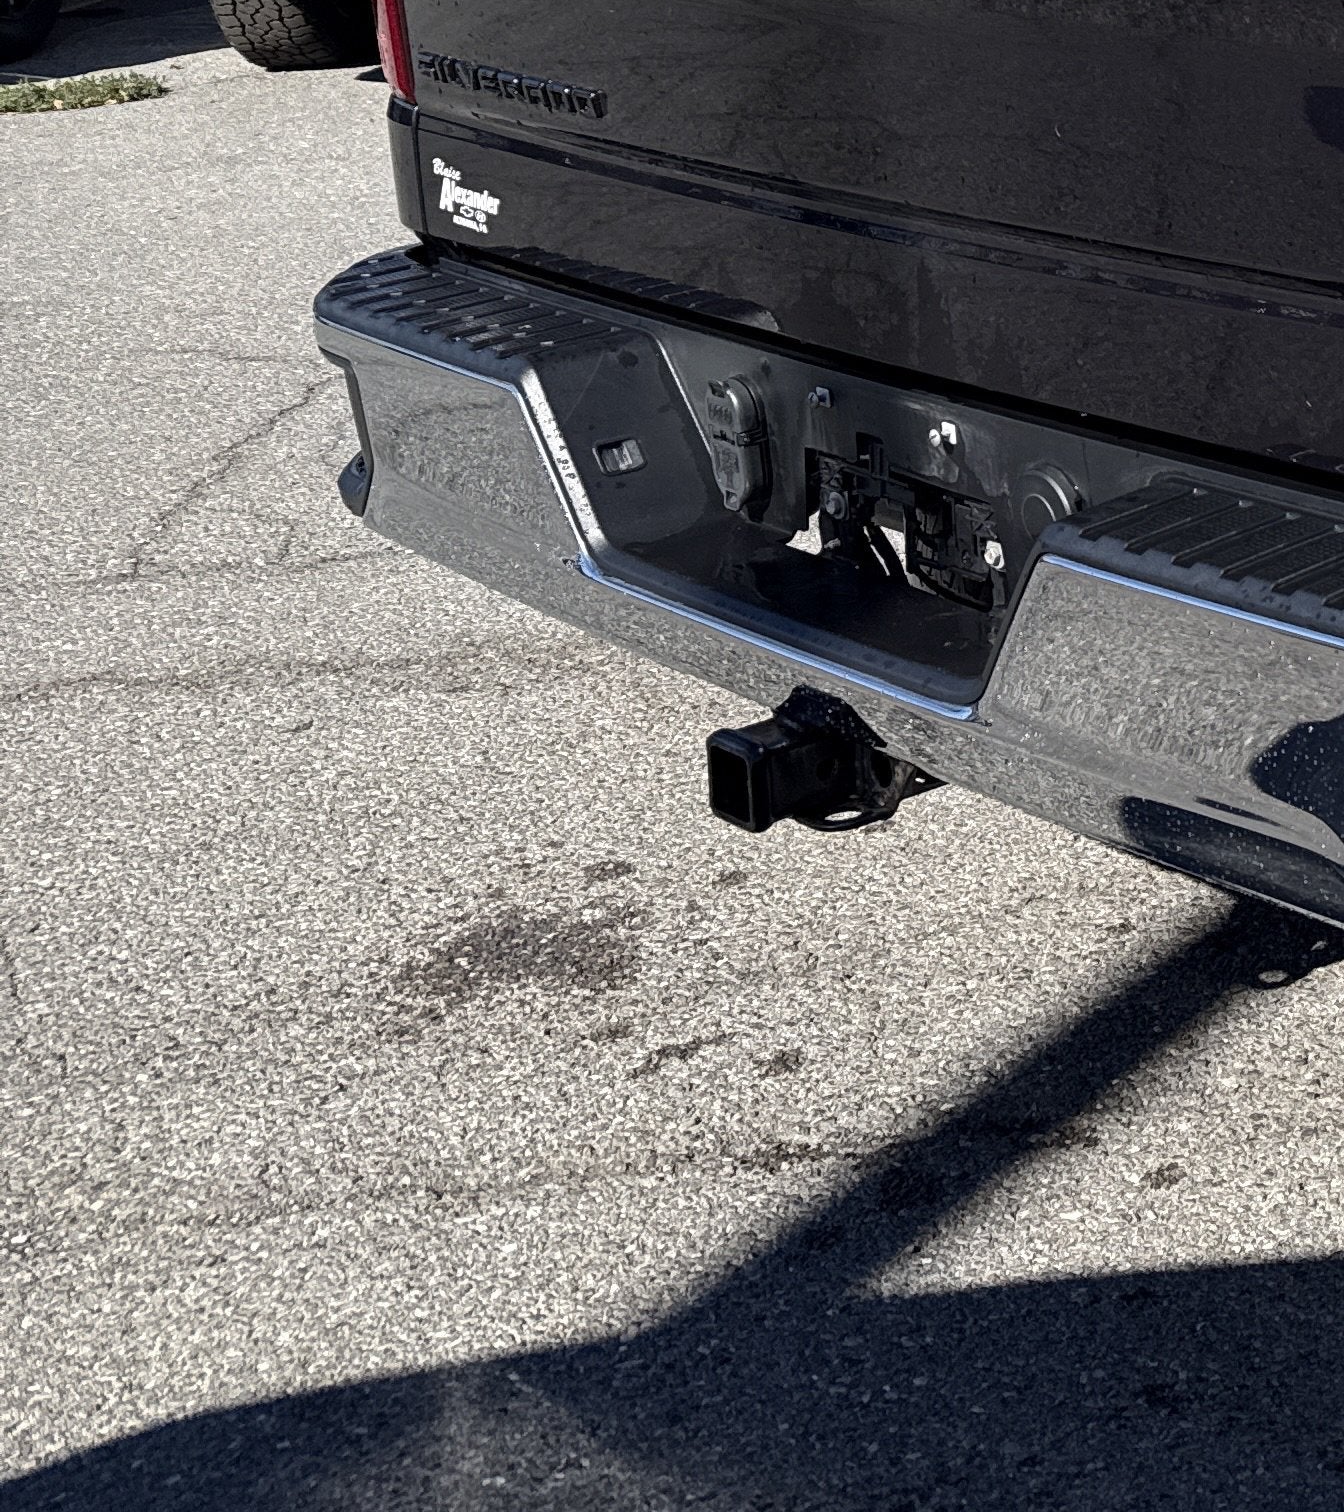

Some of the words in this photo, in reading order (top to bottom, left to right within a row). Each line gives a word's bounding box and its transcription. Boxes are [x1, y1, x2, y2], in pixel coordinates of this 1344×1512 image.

[417, 51, 609, 119] SILVERADO
[432, 157, 461, 181] Blaise
[439, 177, 501, 216] Alexander
